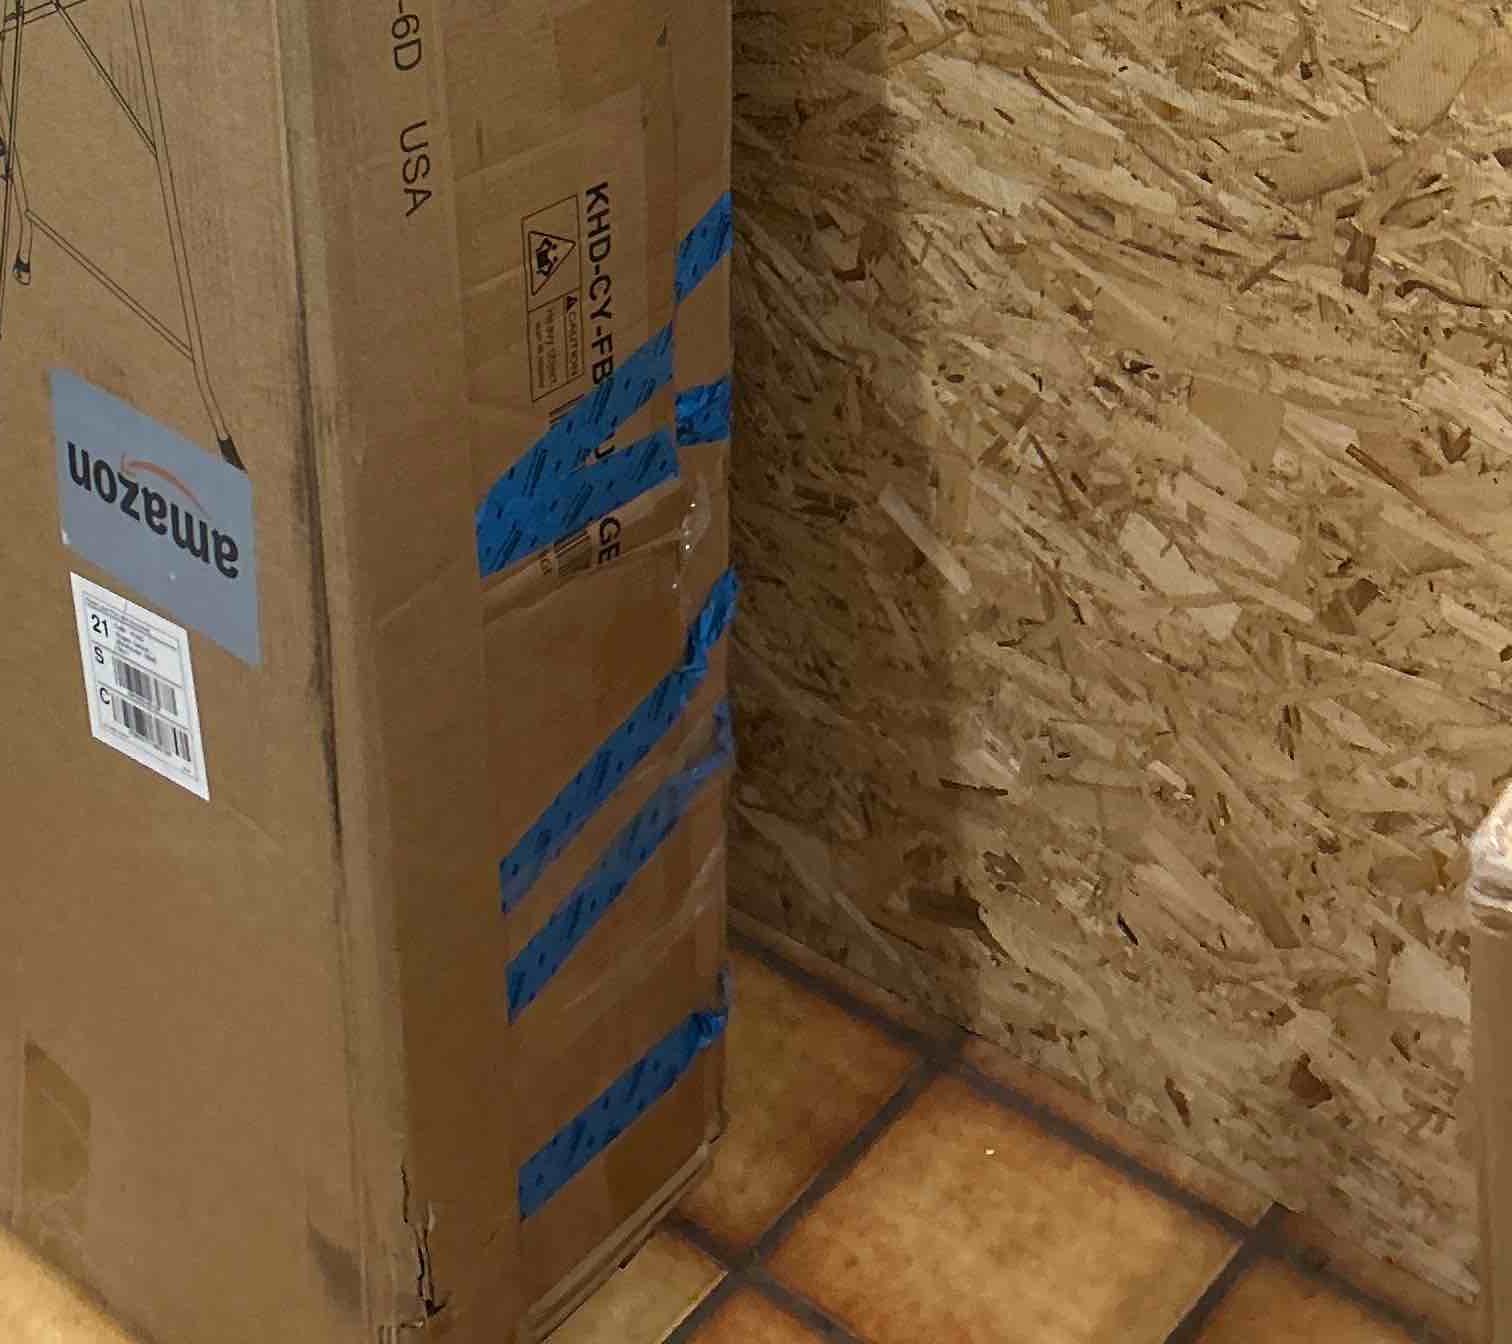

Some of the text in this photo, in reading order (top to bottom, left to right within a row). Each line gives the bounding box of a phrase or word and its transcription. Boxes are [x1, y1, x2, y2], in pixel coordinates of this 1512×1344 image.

[398, 120, 433, 218] USA
[66, 439, 240, 581] amazon
[90, 614, 110, 639] 21
